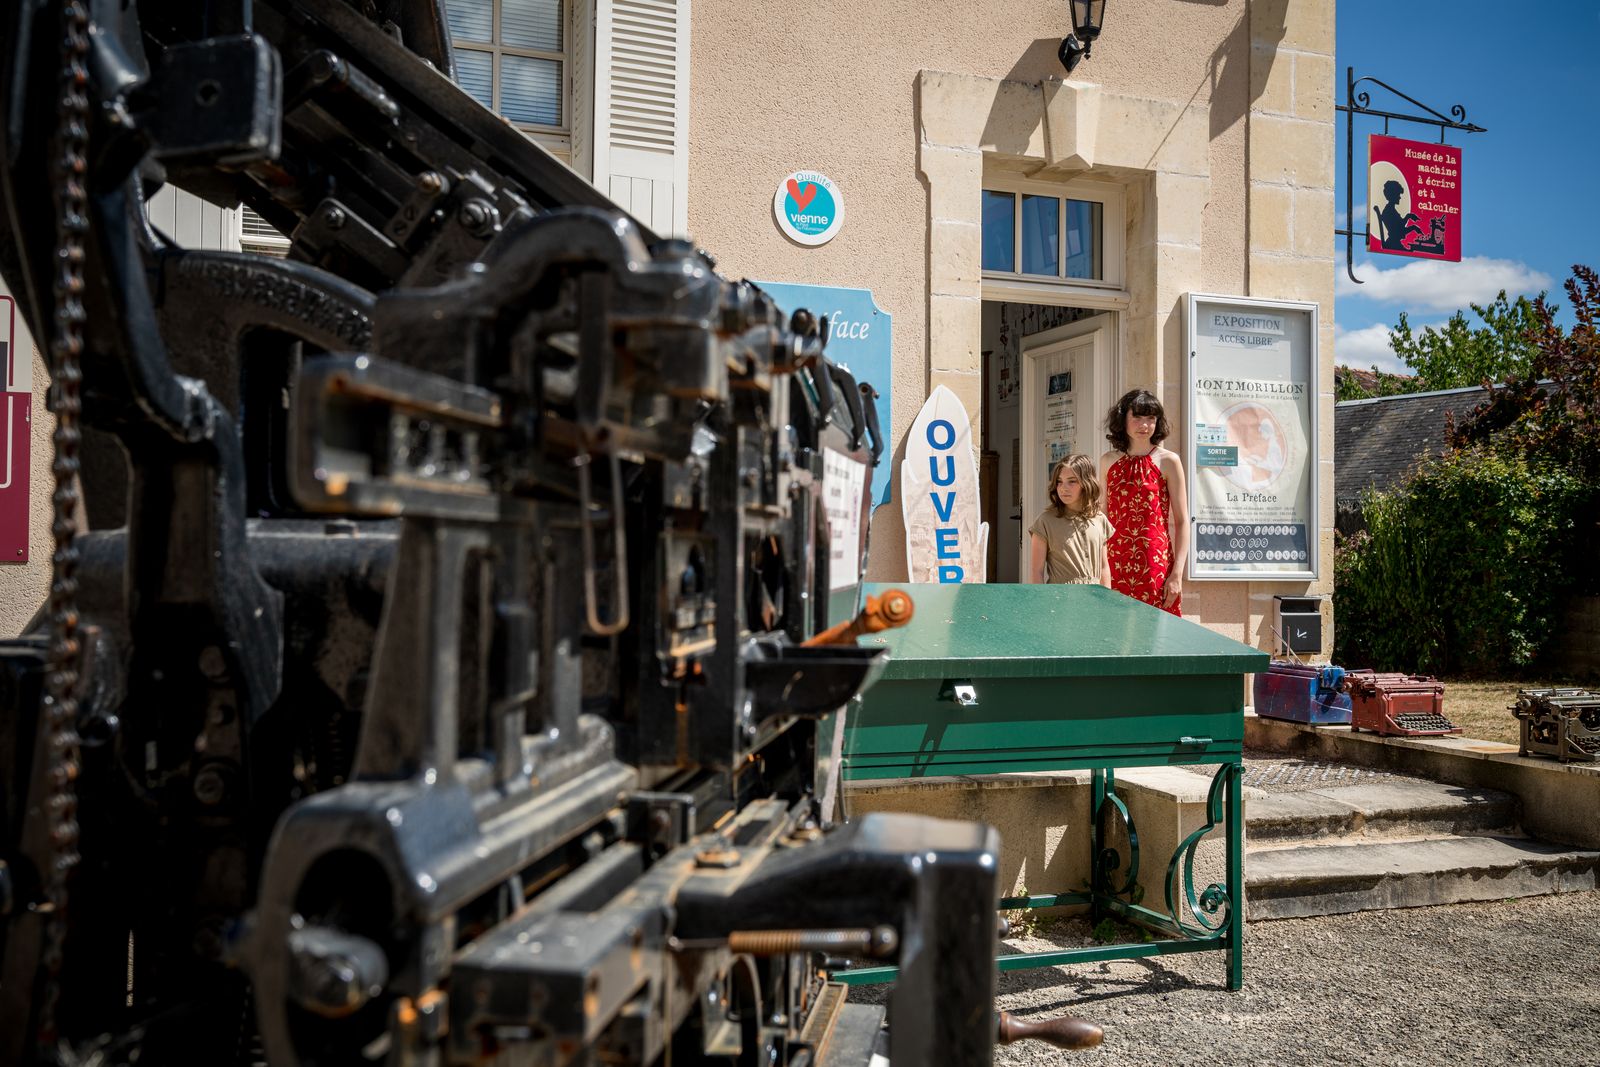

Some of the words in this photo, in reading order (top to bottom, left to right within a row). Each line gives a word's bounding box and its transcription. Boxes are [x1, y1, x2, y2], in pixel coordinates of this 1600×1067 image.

[1405, 148, 1431, 161] Musée
[1433, 152, 1443, 162] de
[1446, 155, 1456, 164] la
[1418, 164, 1457, 176] machine
[796, 173, 831, 189] Qualité
[1418, 175, 1423, 185] à
[1426, 177, 1455, 188] écrire
[1418, 188, 1428, 198] et
[1430, 189, 1436, 199] à
[1418, 202, 1458, 214] calculer
[790, 213, 829, 225] vienne
[825, 310, 870, 345] face
[1214, 316, 1280, 330] EXPOSITION
[1247, 336, 1273, 346] LIBRE
[926, 419, 965, 584] OUVER
[1226, 492, 1239, 502] La
[1242, 493, 1277, 503] Préface
